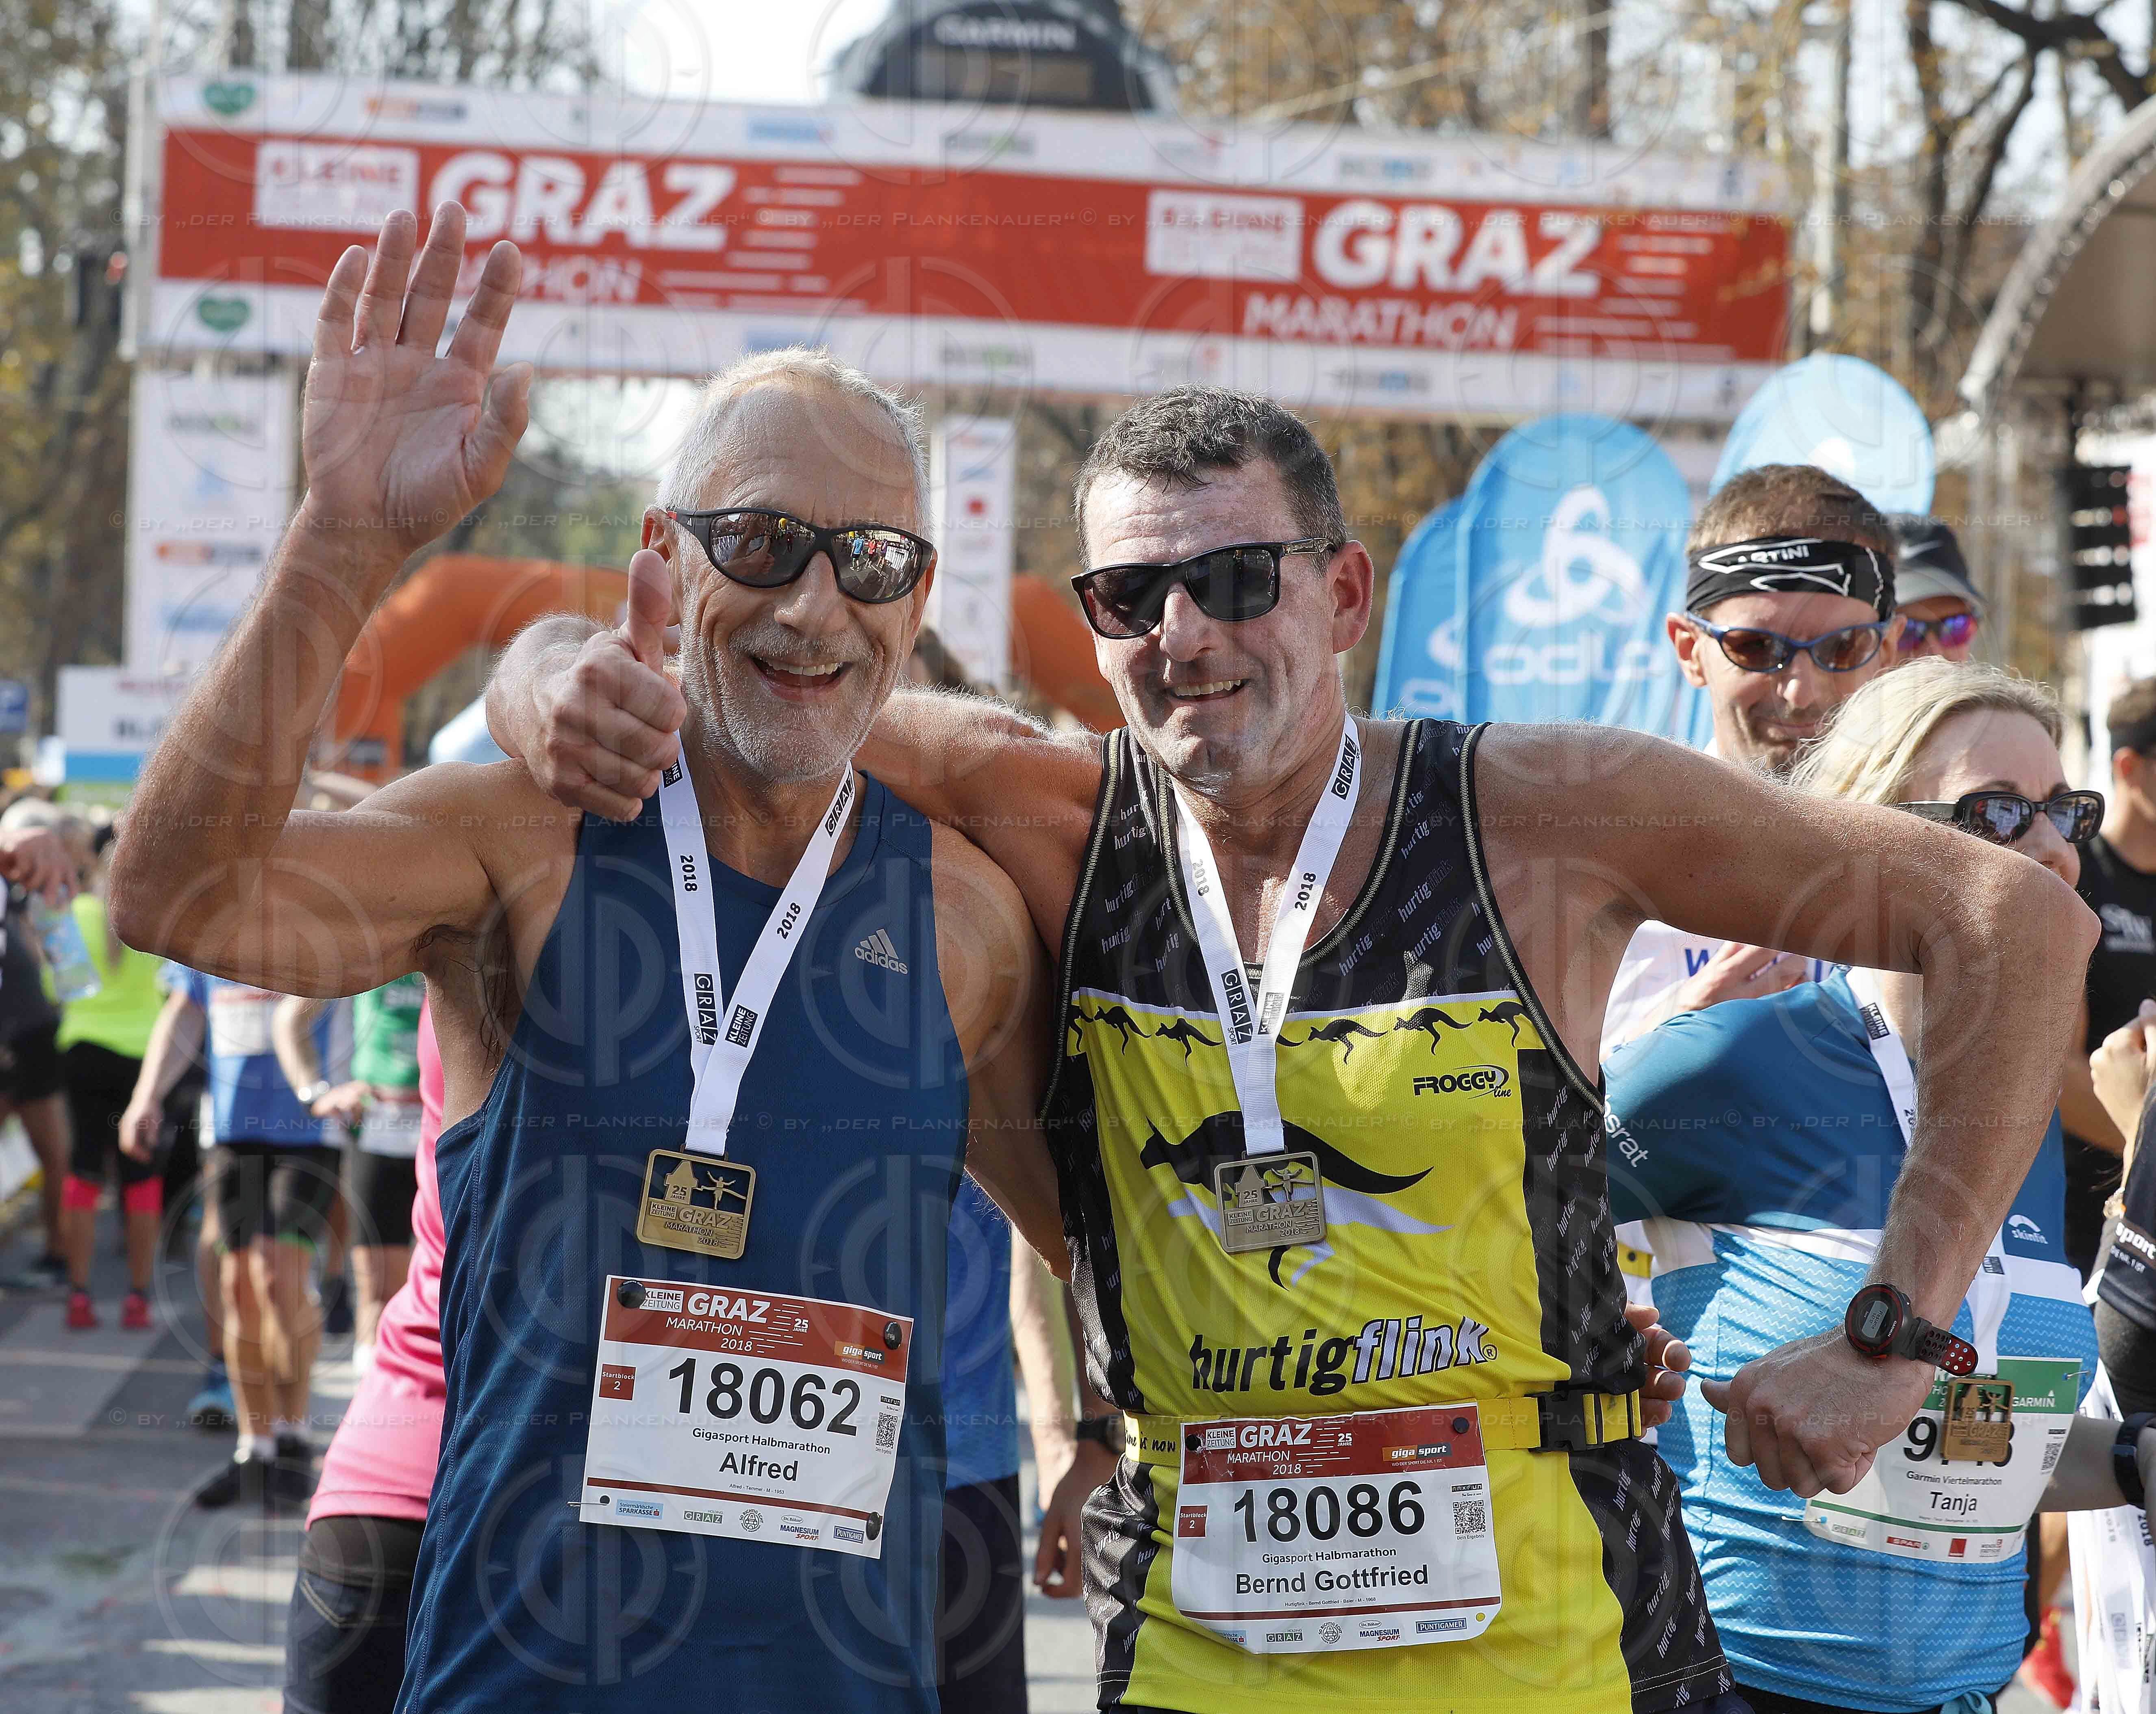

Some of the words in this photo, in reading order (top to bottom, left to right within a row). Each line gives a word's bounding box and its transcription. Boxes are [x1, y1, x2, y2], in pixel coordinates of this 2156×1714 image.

[429, 151, 737, 251] GRAZ
[1313, 199, 1601, 298] GRAZ
[1245, 293, 1517, 349] MARATHON
[1334, 736, 1356, 796] GRAZ
[826, 773, 853, 834] GRAZ
[680, 855, 698, 892] 2018
[1295, 872, 1316, 911] 2018
[777, 902, 801, 940] 2018
[855, 944, 908, 975] adidas
[695, 975, 717, 1043] GRAZ
[1224, 972, 1252, 1041] GRAZ
[728, 1007, 746, 1042] KLEINE
[737, 1011, 755, 1045] ZEITUNG
[1228, 1027, 1237, 1045] SPORT
[1413, 1070, 1496, 1096] FROGGY
[1493, 1086, 1512, 1098] line
[673, 1185, 687, 1196] 25
[1243, 1190, 1258, 1199] 25
[651, 1209, 675, 1218] ZEITUNG
[652, 1203, 676, 1212] KLEINE
[679, 1207, 732, 1229] GRAZ
[1256, 1202, 1305, 1222] GRAZ
[665, 1222, 713, 1236] MARATHON
[1246, 1220, 1292, 1233] MARATHON
[1281, 1228, 1300, 1236] 2018
[698, 1237, 719, 1246] 2018
[641, 1299, 680, 1310] ZEITUNG
[645, 1290, 681, 1301] KLEINE
[688, 1293, 771, 1323] GRAZ
[666, 1317, 743, 1336] MARATHON
[794, 1318, 808, 1329] 25
[1888, 1320, 1897, 1337] GARMIN
[720, 1338, 753, 1351] 2018
[842, 1345, 862, 1356] giga
[863, 1350, 882, 1360] sport
[602, 1372, 635, 1380] Startblock
[613, 1381, 621, 1391] 2
[669, 1357, 861, 1436] 18062
[2012, 1396, 2055, 1407] GARMIN
[692, 1428, 749, 1443] Gigasport
[752, 1435, 830, 1454] Halbmarathon
[1140, 1431, 1147, 1450] is
[1152, 1438, 1175, 1452] now
[1207, 1430, 1235, 1439] KLEINE
[1240, 1423, 1313, 1448] GRAZ
[1207, 1438, 1235, 1447] ZEITUNG
[1338, 1433, 1352, 1442] 25
[1227, 1450, 1290, 1464] MARATHON
[1392, 1448, 1415, 1459] giga
[1418, 1445, 1447, 1456] sport
[719, 1452, 799, 1481] Alfred
[1273, 1464, 1301, 1475] 2018
[1906, 1470, 1941, 1483] Garmin
[1943, 1476, 2002, 1485] Viertelmarathon
[1234, 1481, 1425, 1542] 18086
[1930, 1491, 1977, 1516] Tanja
[685, 1512, 722, 1523] GRAZ
[1189, 1520, 1195, 1529] 2
[780, 1525, 819, 1536] MAGNESIUM
[836, 1529, 863, 1542] PUNTIGAMER
[2137, 1514, 2153, 1546] 2018
[1893, 1538, 1921, 1548] SPAR
[1262, 1553, 1313, 1565] Gigasport
[1315, 1548, 1397, 1561] Halbmarathon
[1236, 1571, 1306, 1594] Bernd
[1315, 1564, 1428, 1591] Gottfried
[1360, 1629, 1399, 1637] MAGNESIUM
[1420, 1621, 1463, 1631] PUNTIGAMER
[1267, 1633, 1303, 1642] GRAZ
